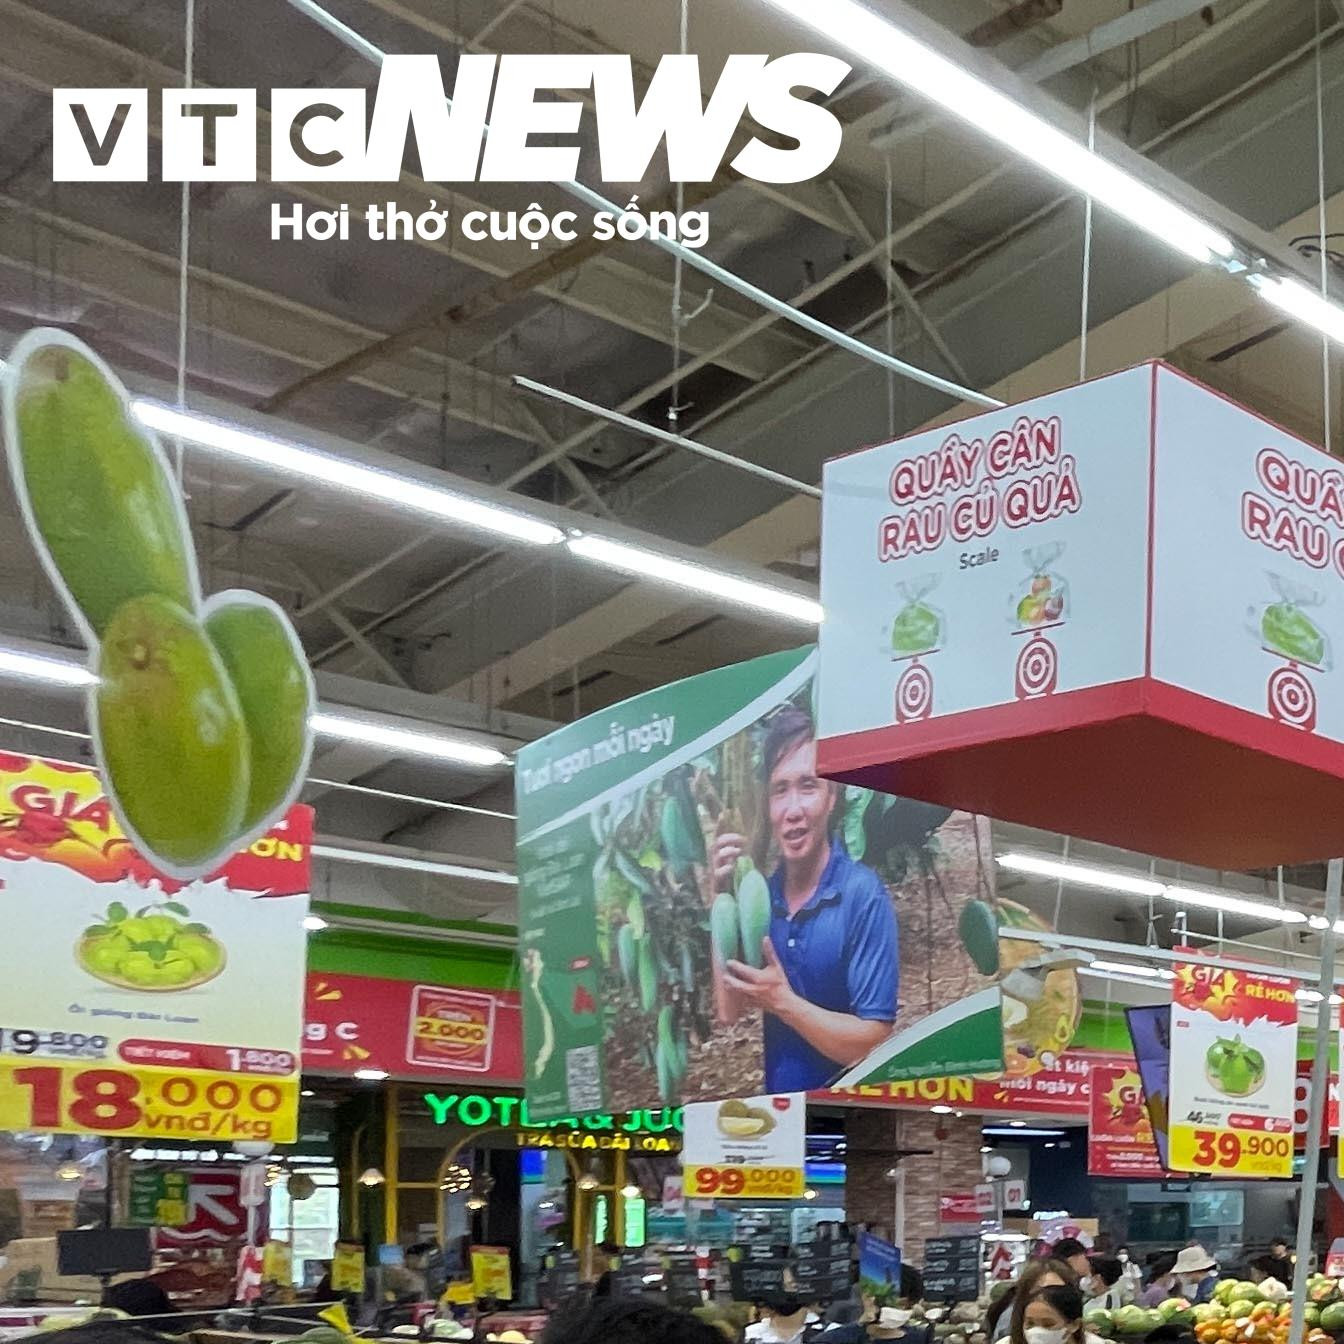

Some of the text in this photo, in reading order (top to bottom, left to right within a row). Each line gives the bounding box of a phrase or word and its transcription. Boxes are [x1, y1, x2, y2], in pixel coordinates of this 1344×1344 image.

[987, 416, 1060, 478] CÂN
[879, 455, 1081, 561] RAU CỦ QUẢ
[1242, 492, 1329, 568] RAU
[959, 547, 999, 569] Scale
[145, 1112, 273, 1140] vnđ/kg
